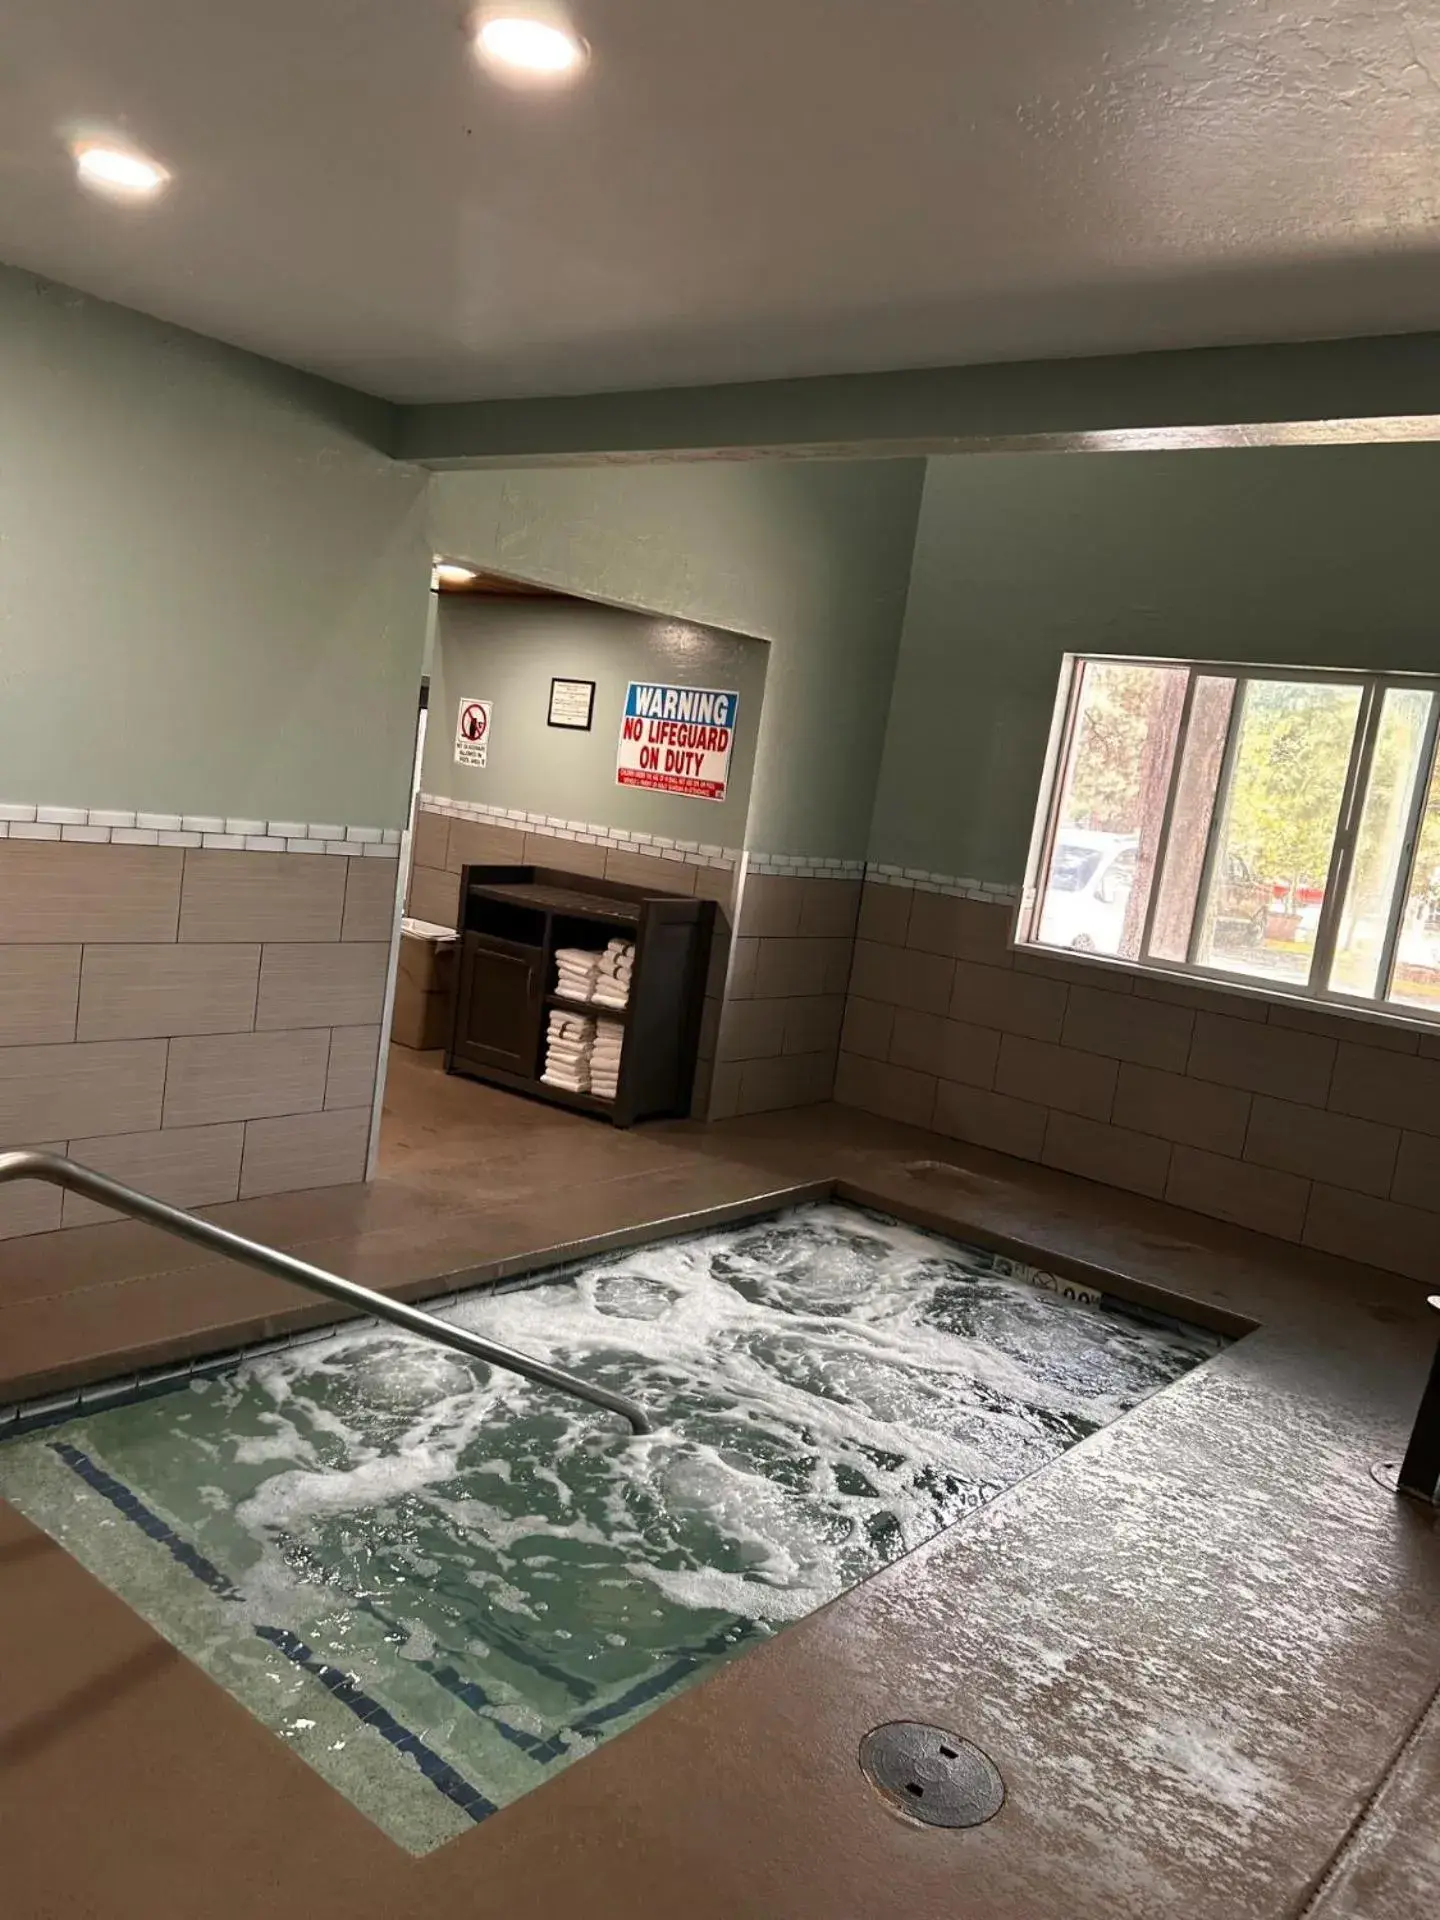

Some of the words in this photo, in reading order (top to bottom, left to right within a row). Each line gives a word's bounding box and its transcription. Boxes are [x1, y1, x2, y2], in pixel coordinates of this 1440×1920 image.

[635, 686, 729, 725] WARNING
[623, 717, 643, 742] NO
[648, 720, 729, 752] LIFEGUARD
[640, 745, 660, 770] ON
[665, 748, 705, 777] DUTY
